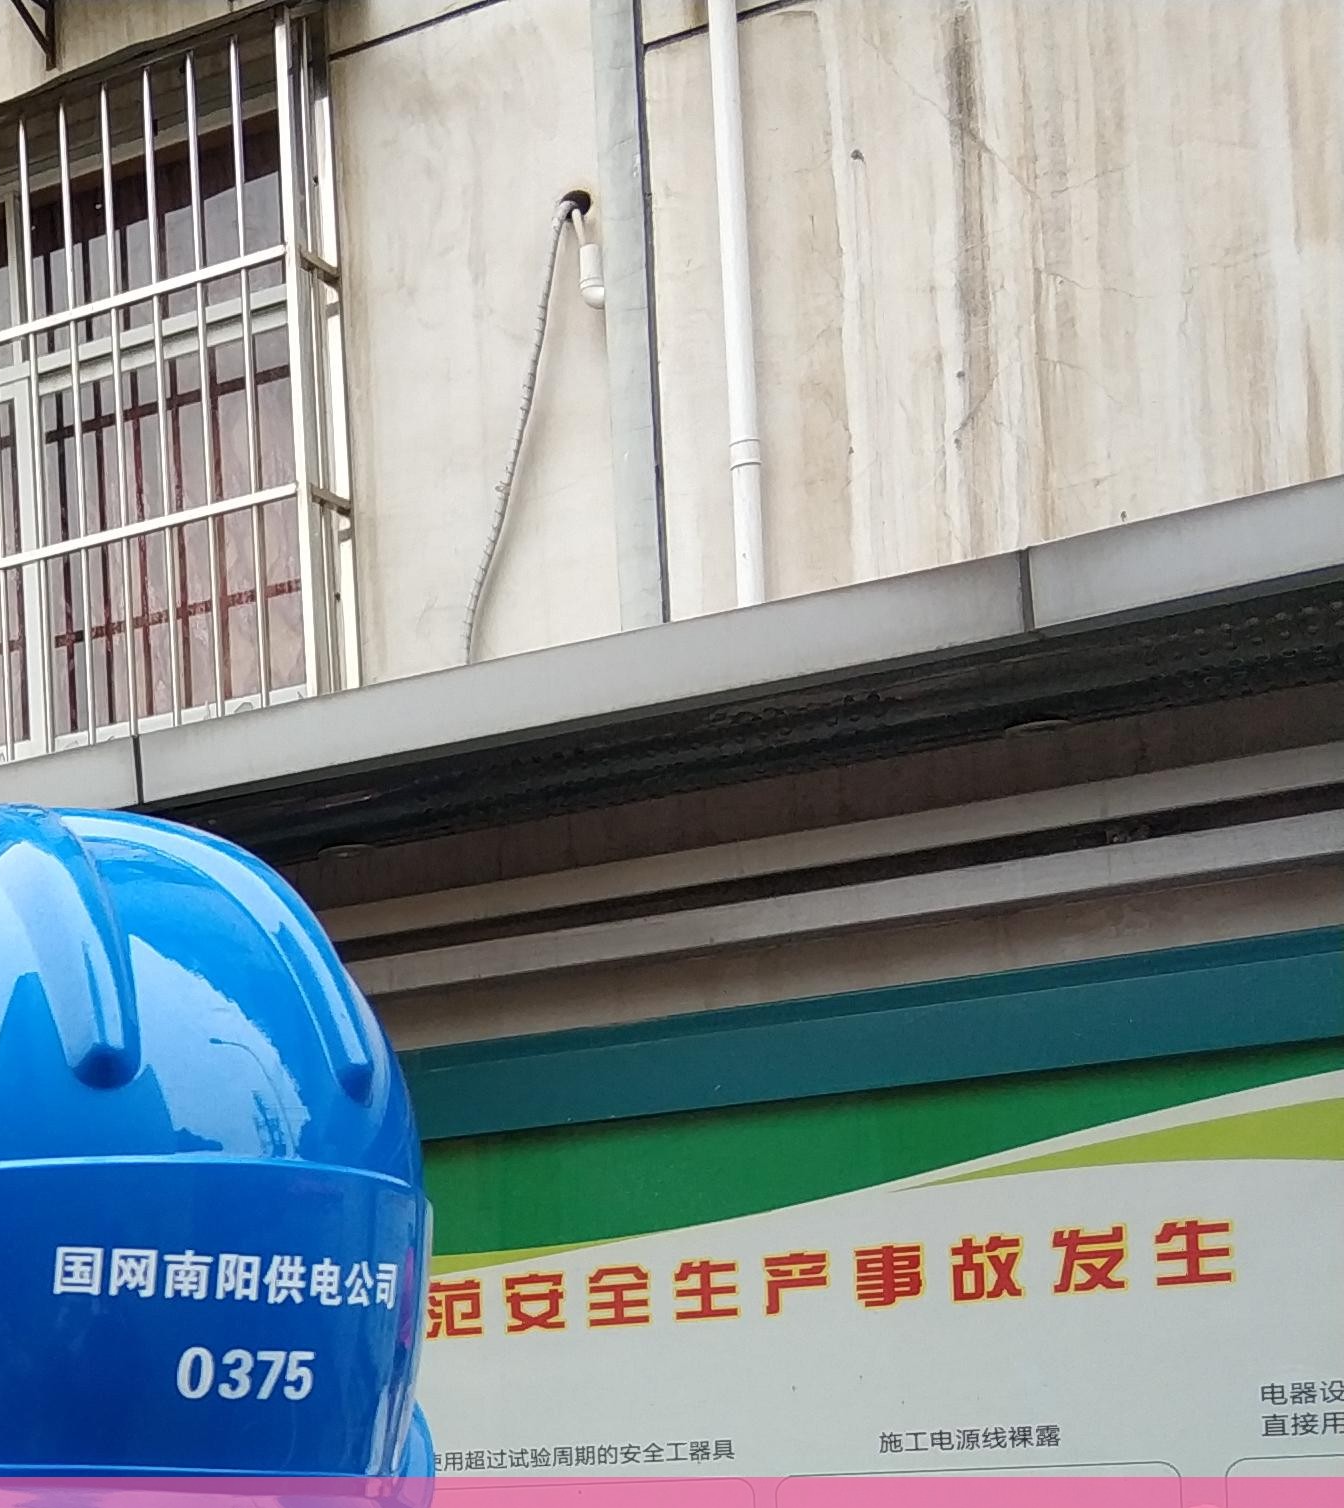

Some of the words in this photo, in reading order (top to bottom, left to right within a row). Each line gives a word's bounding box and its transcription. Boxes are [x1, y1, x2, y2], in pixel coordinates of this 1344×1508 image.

[52, 1245, 399, 1310] 国网南阳供电公司
[426, 1218, 1235, 1340] 范安全生产事故发生
[176, 1346, 315, 1400] 0375
[1260, 1380, 1344, 1406] 电器设
[879, 1424, 1061, 1454] 施工电源线裸露
[1261, 1412, 1344, 1437] 直接用
